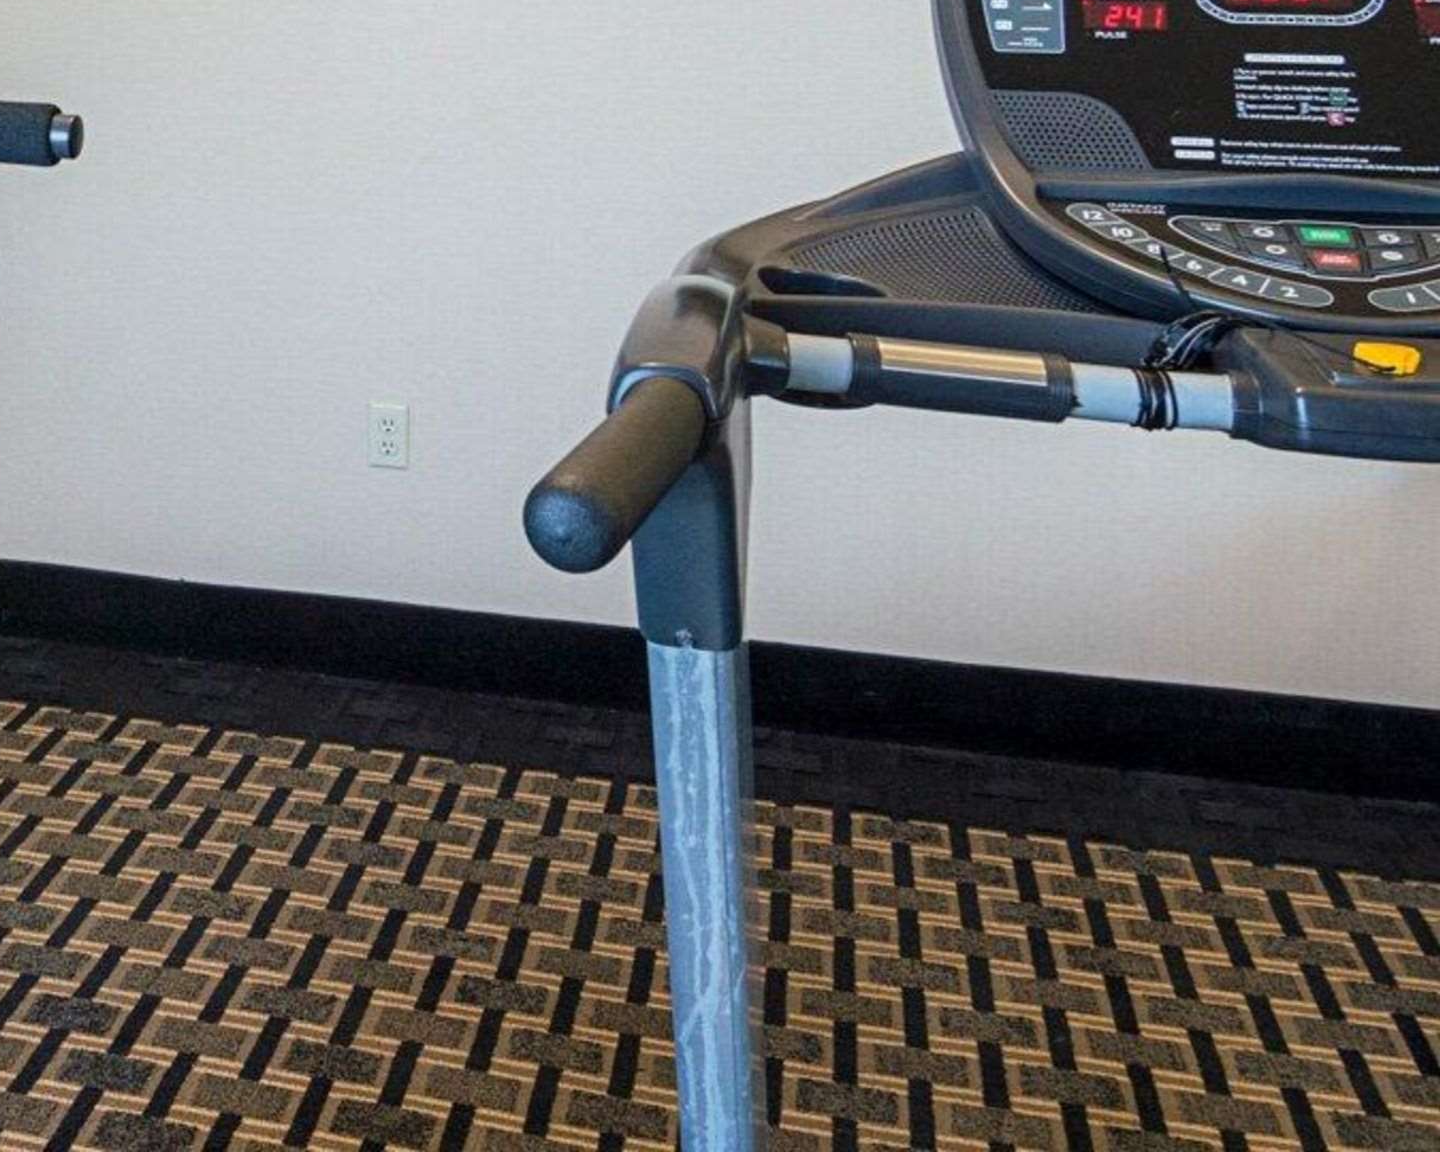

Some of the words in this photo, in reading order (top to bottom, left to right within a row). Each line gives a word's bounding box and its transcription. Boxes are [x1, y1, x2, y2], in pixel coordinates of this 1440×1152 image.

[1104, 4, 1166, 29] 241
[1094, 31, 1128, 39] PULSE
[1080, 209, 1106, 221] 12
[1111, 226, 1134, 238] 10
[1147, 243, 1161, 254] 8
[1186, 259, 1203, 271] 6
[1231, 274, 1248, 286] 4
[1280, 285, 1300, 298] 2
